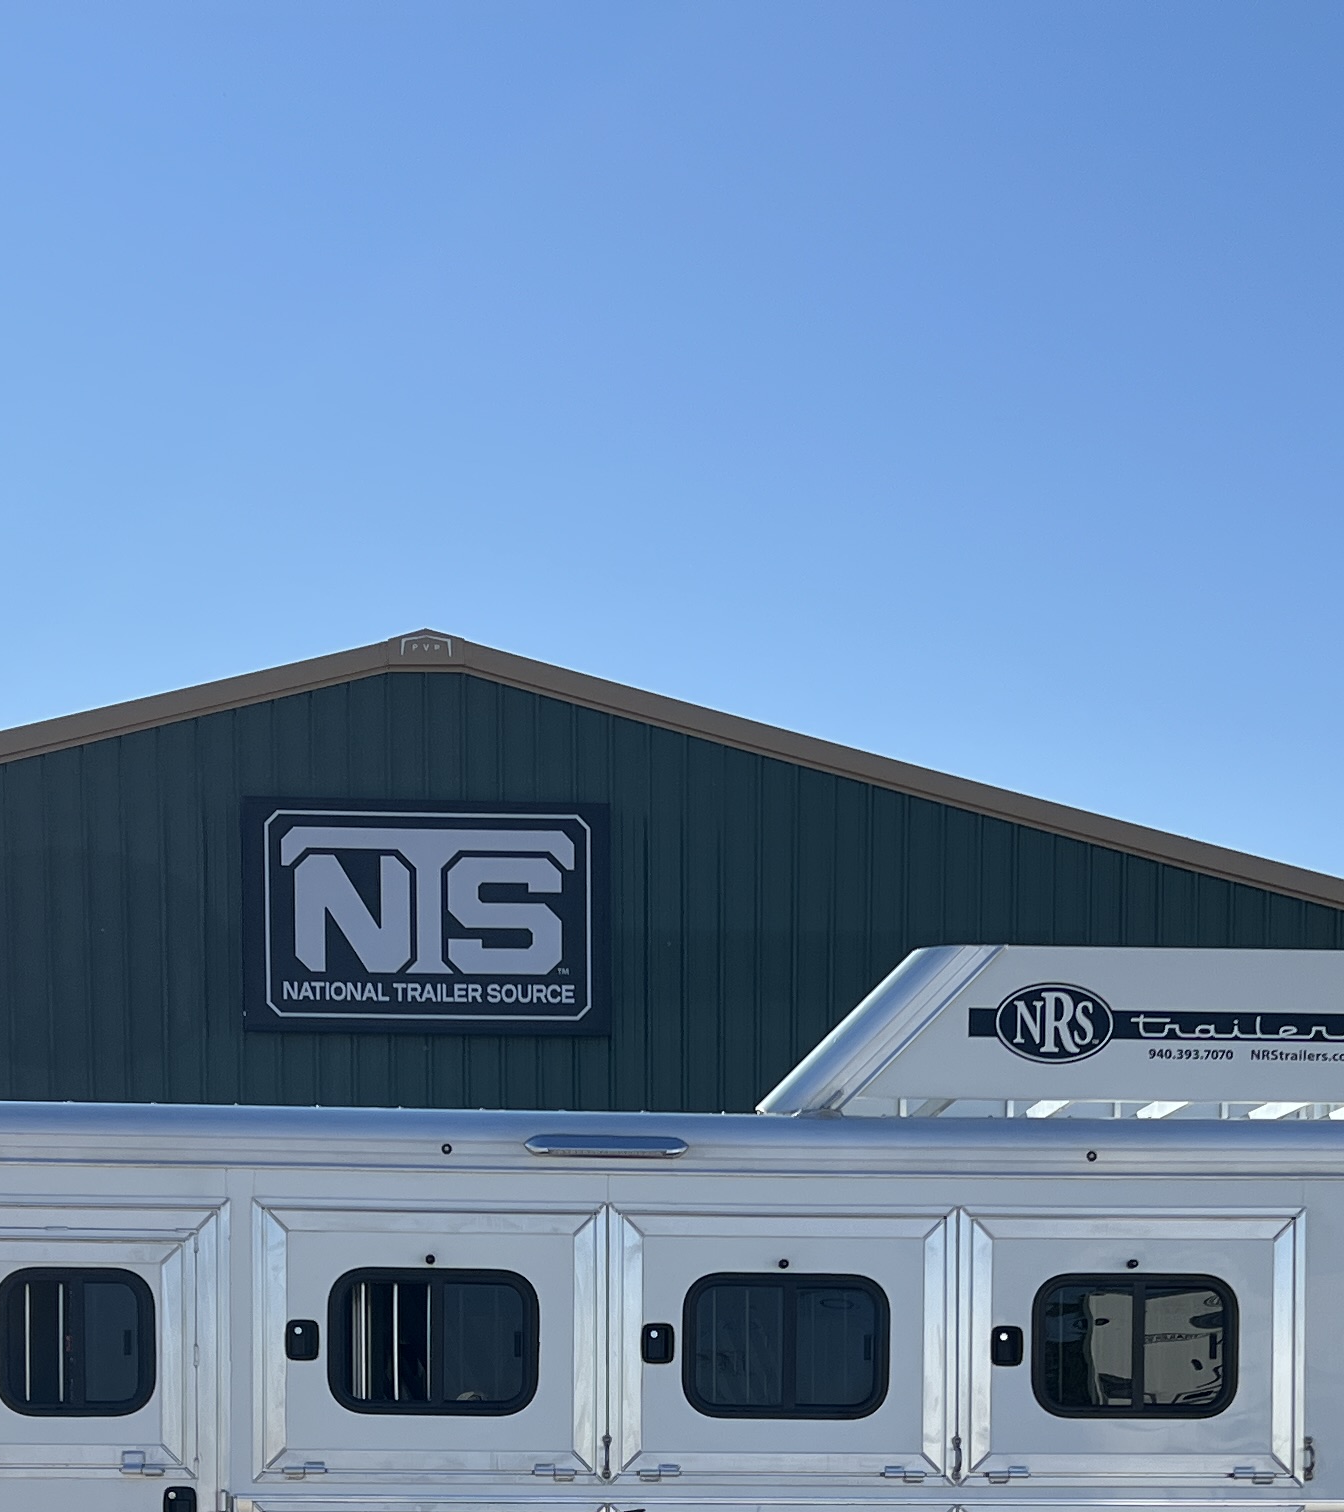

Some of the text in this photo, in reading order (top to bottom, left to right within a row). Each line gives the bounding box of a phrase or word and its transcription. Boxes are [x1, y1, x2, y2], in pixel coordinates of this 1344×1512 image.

[281, 826, 575, 975] NTS
[282, 980, 575, 1004] NATIONAL TRAILER SOURCE
[1012, 991, 1095, 1054] NRS
[1147, 1048, 1234, 1061] 940.393.7070
